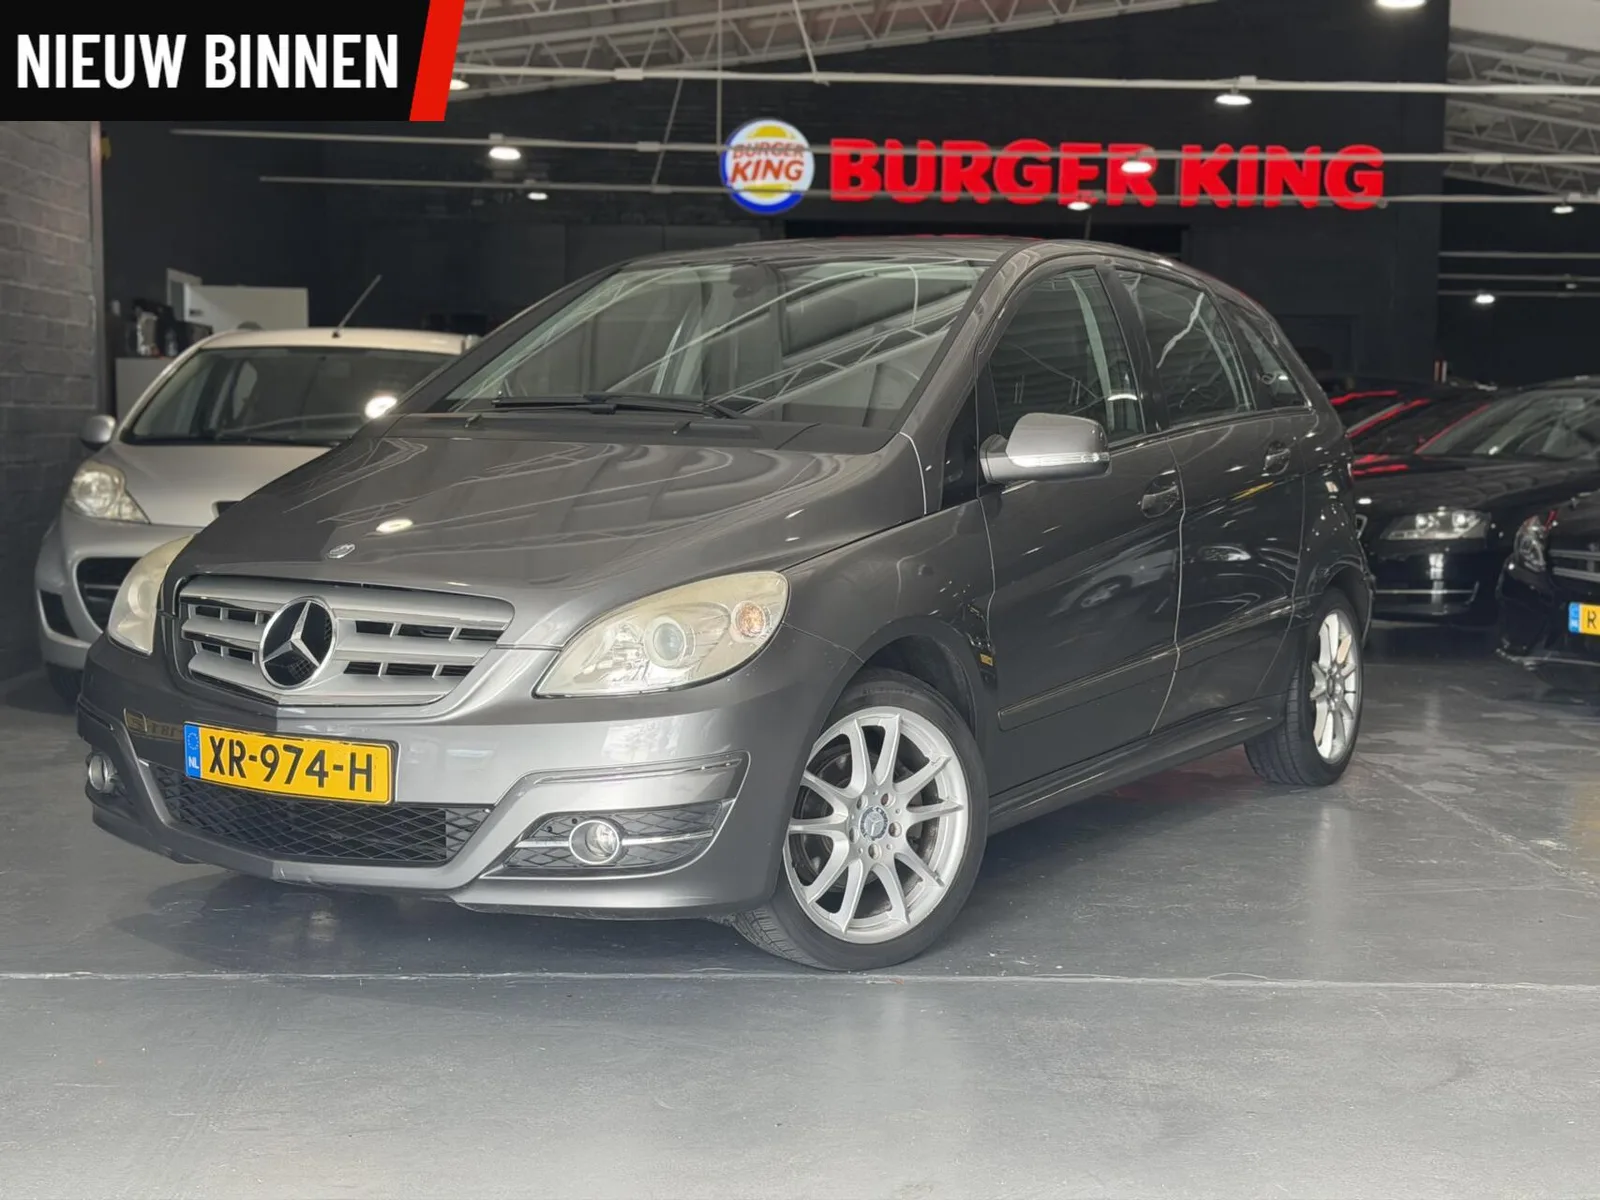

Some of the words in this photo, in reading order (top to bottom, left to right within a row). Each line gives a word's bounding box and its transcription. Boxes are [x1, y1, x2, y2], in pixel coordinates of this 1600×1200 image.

[731, 159, 804, 184] KING
[829, 137, 1159, 206] BURGER
[1178, 142, 1385, 210] KING
[188, 756, 199, 770] NL
[209, 735, 373, 793] XR-974-H
